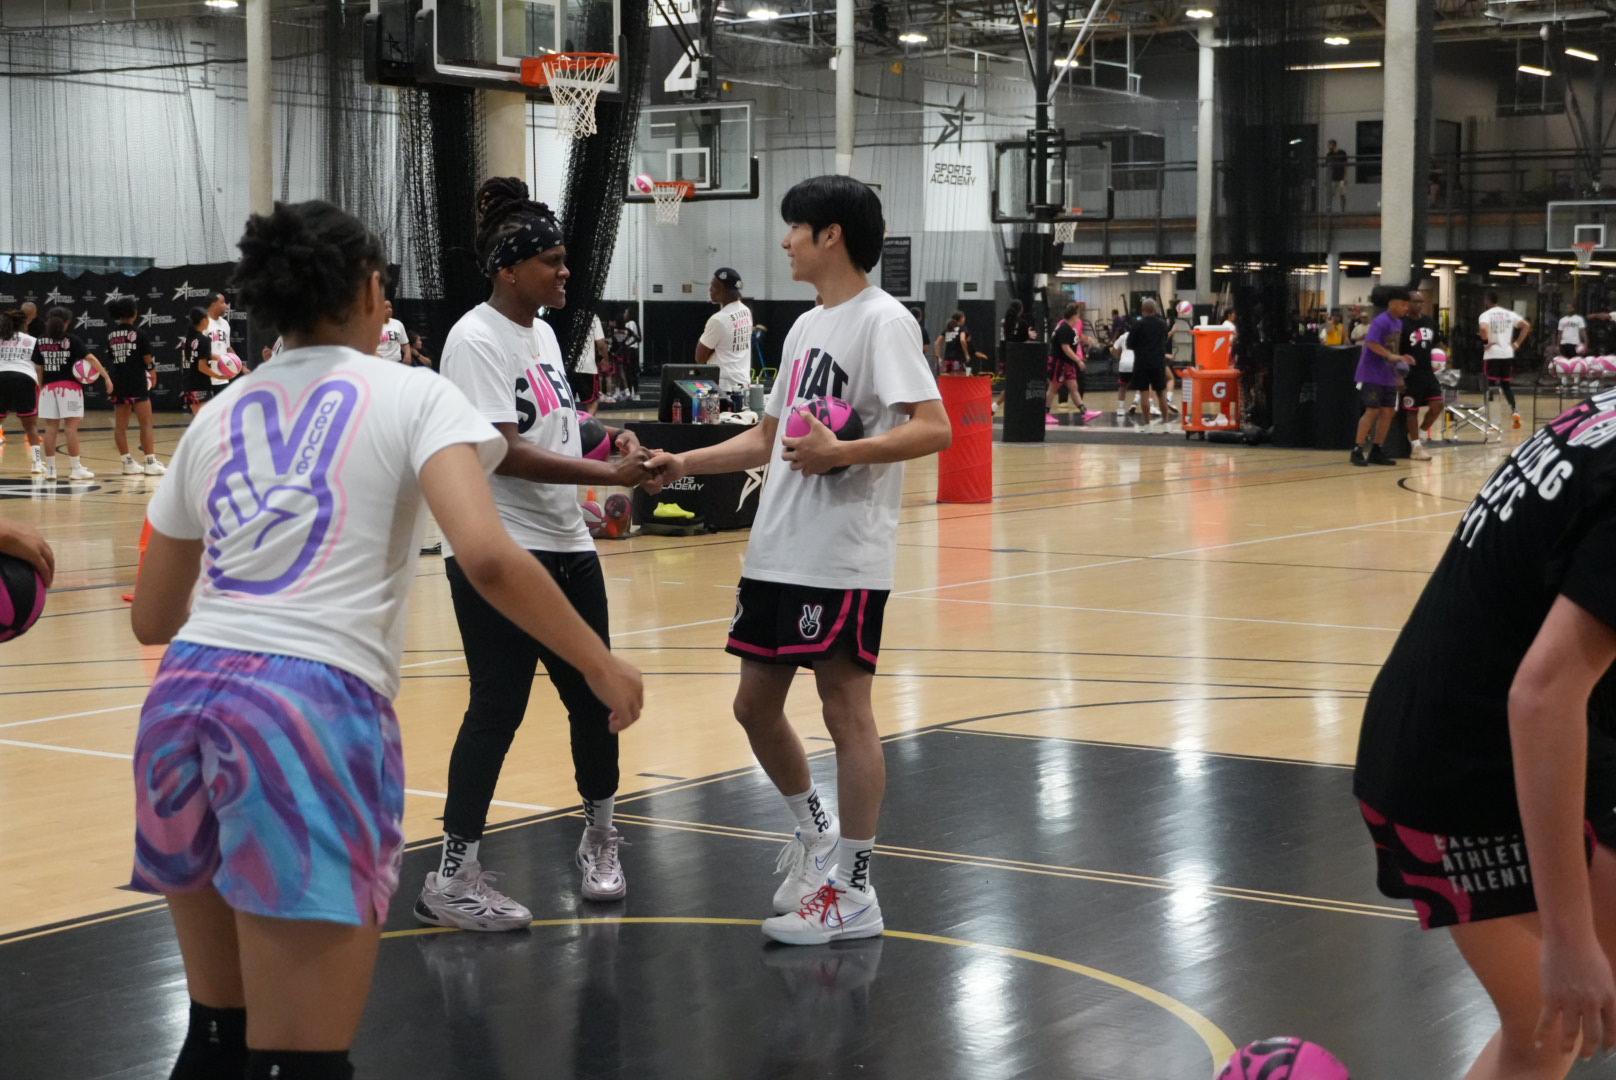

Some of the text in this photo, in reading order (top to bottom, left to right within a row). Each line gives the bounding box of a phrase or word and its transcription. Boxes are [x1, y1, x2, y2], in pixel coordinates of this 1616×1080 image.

[656, 0, 699, 16] COU
[664, 39, 700, 93] 4
[935, 162, 972, 176] SPORTS
[930, 174, 976, 187] ACADEMY
[1212, 381, 1227, 399] G
[295, 399, 338, 476] deuce
[1447, 864, 1528, 895] TALENT
